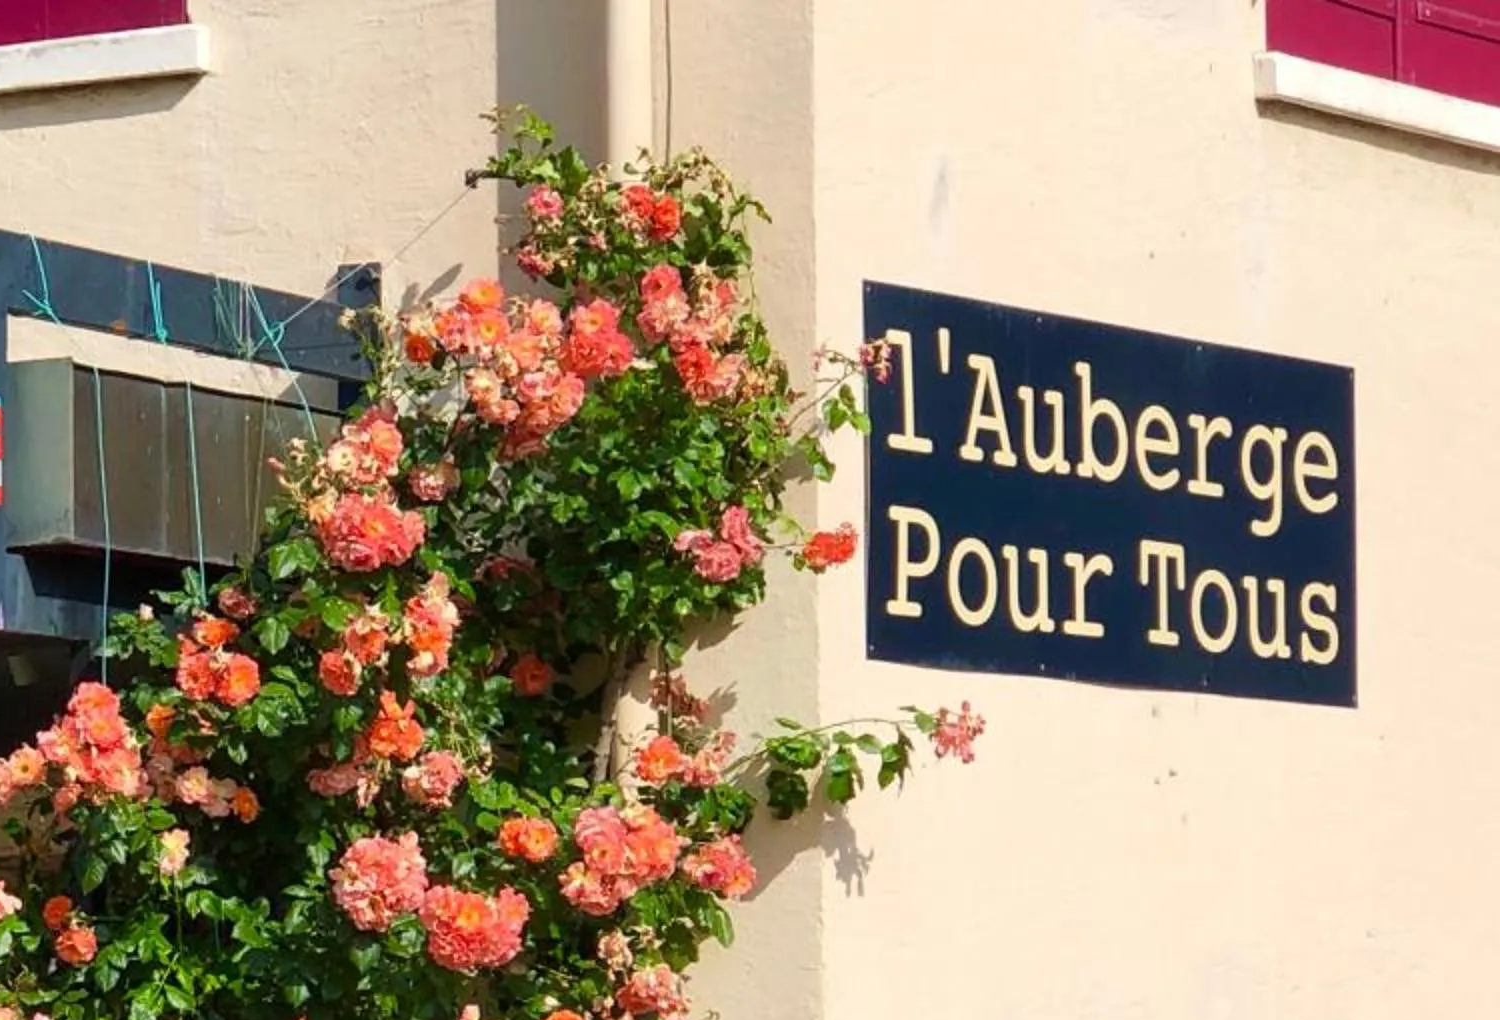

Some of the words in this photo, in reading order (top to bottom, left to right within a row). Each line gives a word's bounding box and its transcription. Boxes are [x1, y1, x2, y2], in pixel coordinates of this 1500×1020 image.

[886, 327, 1340, 537] l'Auberge
[886, 506, 1113, 637] Pour
[1140, 540, 1338, 664] Tous
